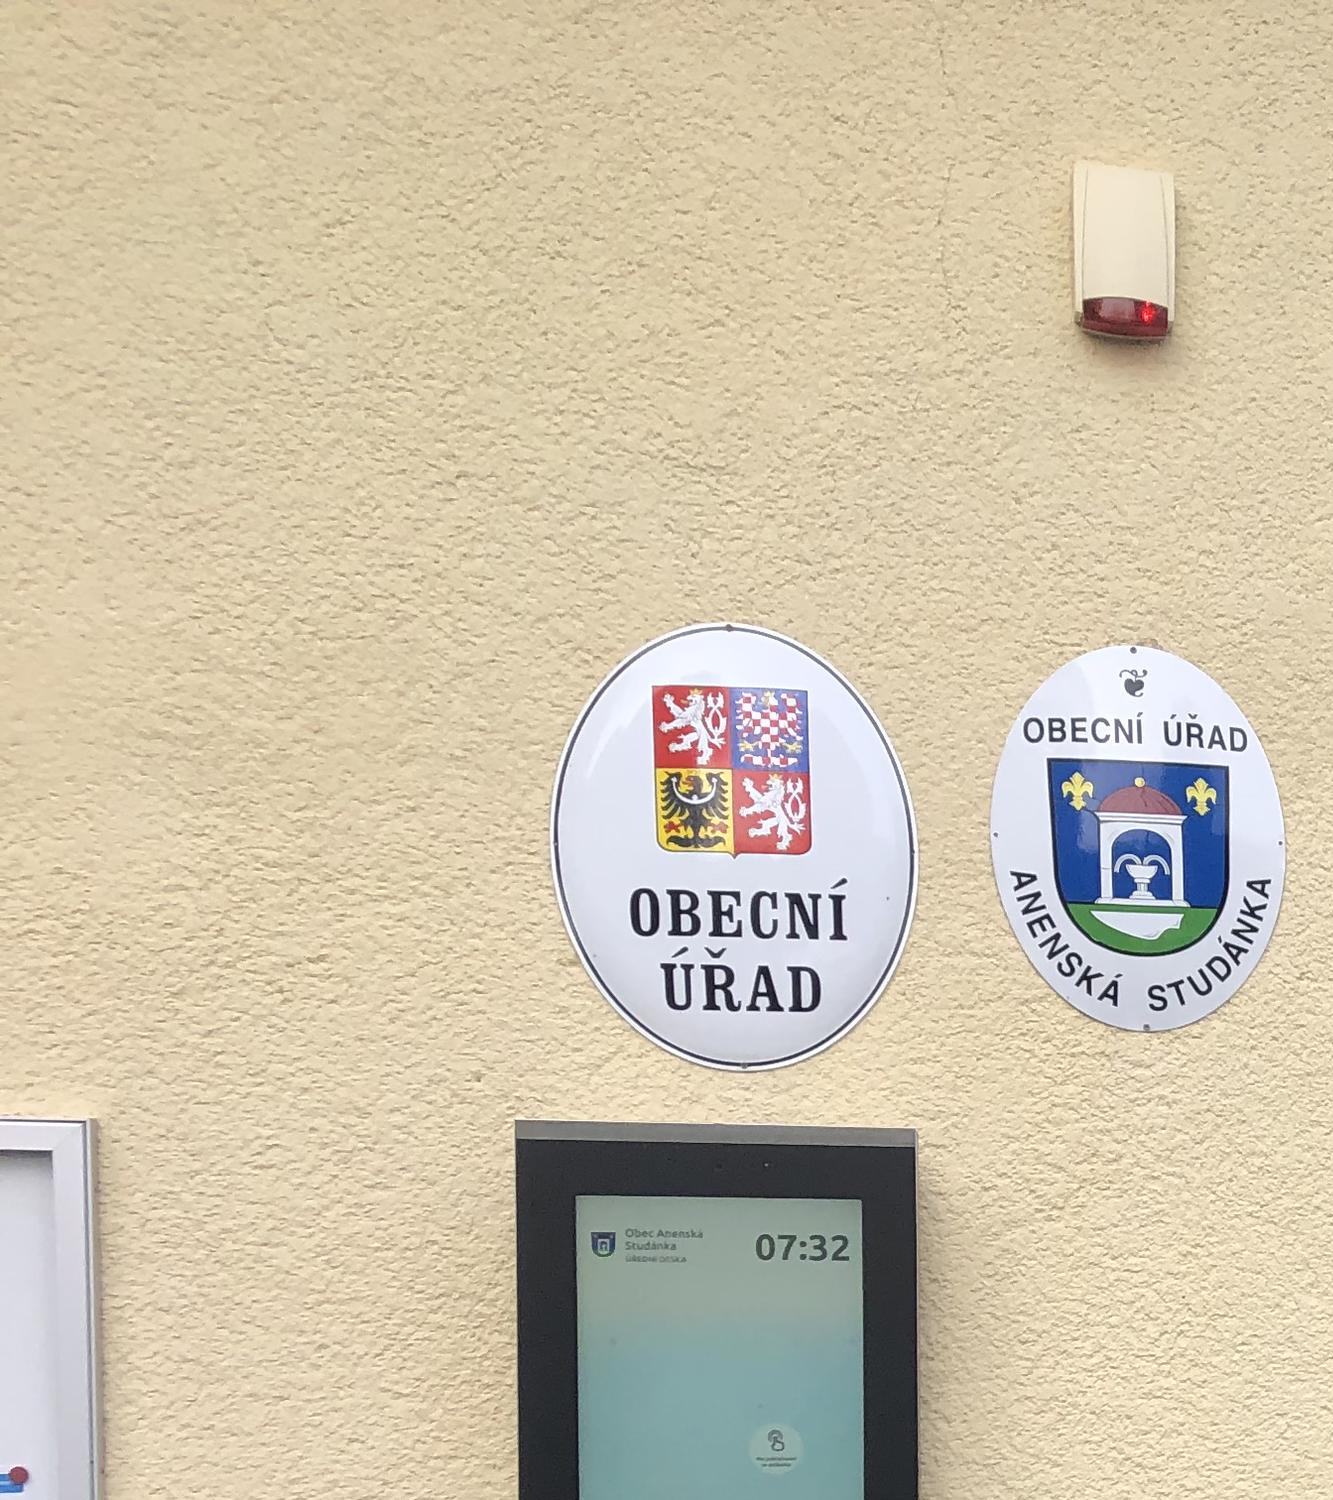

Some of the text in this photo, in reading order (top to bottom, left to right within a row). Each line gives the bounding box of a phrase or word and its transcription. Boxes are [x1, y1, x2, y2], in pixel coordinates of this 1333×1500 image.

[1023, 711, 1248, 753] OBECNÍ ÚŘAD
[629, 878, 849, 941] OBECNÍ
[1009, 869, 1271, 1012] ANENSKÁ STUDÁNKA
[660, 946, 822, 1013] ÚŘAD
[625, 1228, 654, 1238] Obec
[755, 1233, 850, 1262] 07:32
